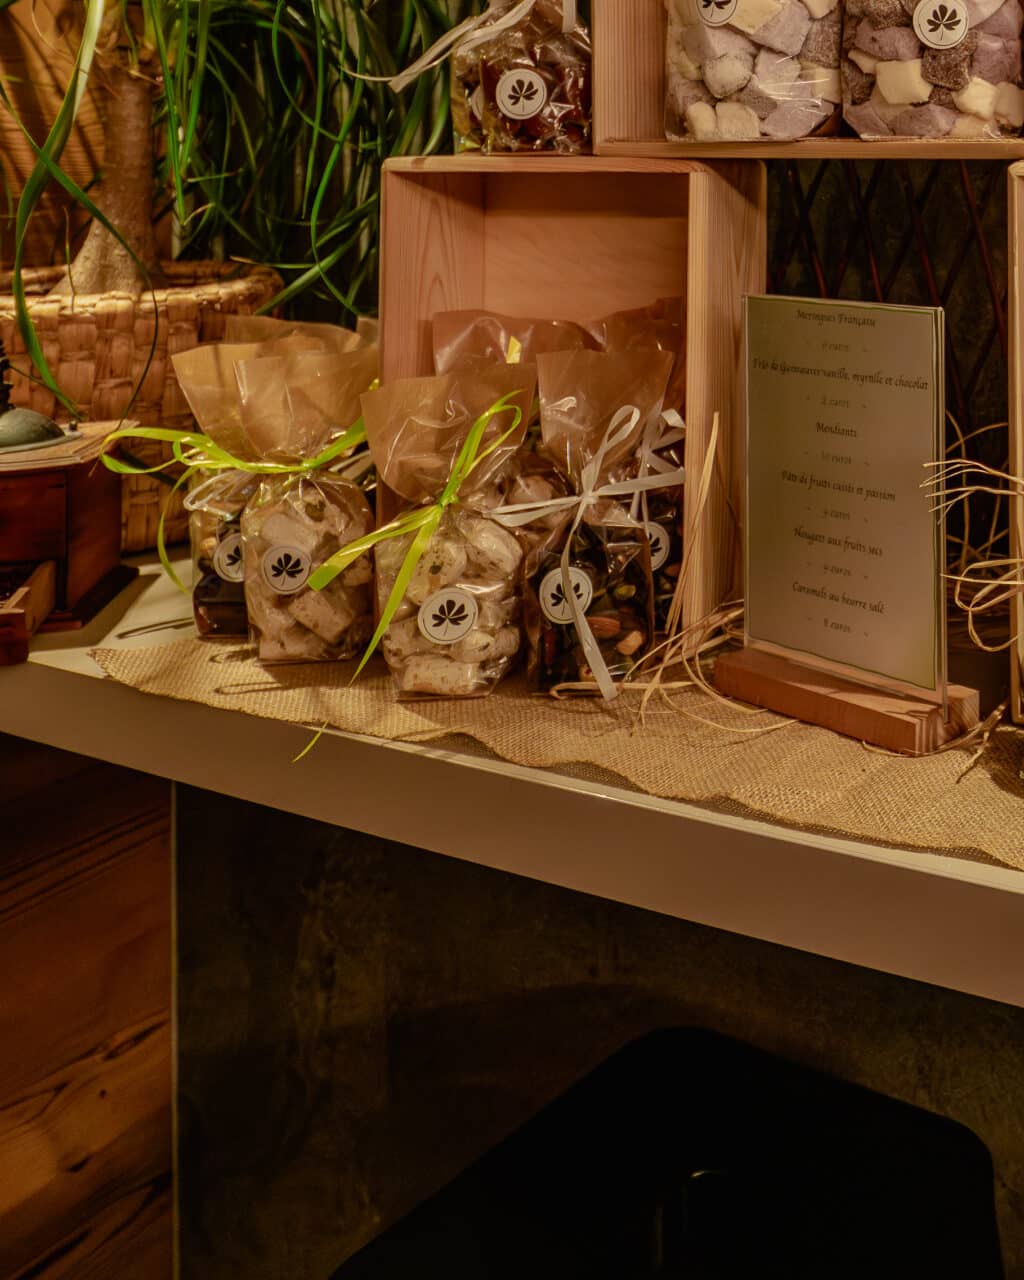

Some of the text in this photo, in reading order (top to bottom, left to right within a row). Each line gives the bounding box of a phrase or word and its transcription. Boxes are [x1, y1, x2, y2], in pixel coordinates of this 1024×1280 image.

[894, 375, 929, 391] chocolat
[843, 536, 866, 553] fruits
[828, 592, 840, 603] au
[841, 592, 867, 610] beurre
